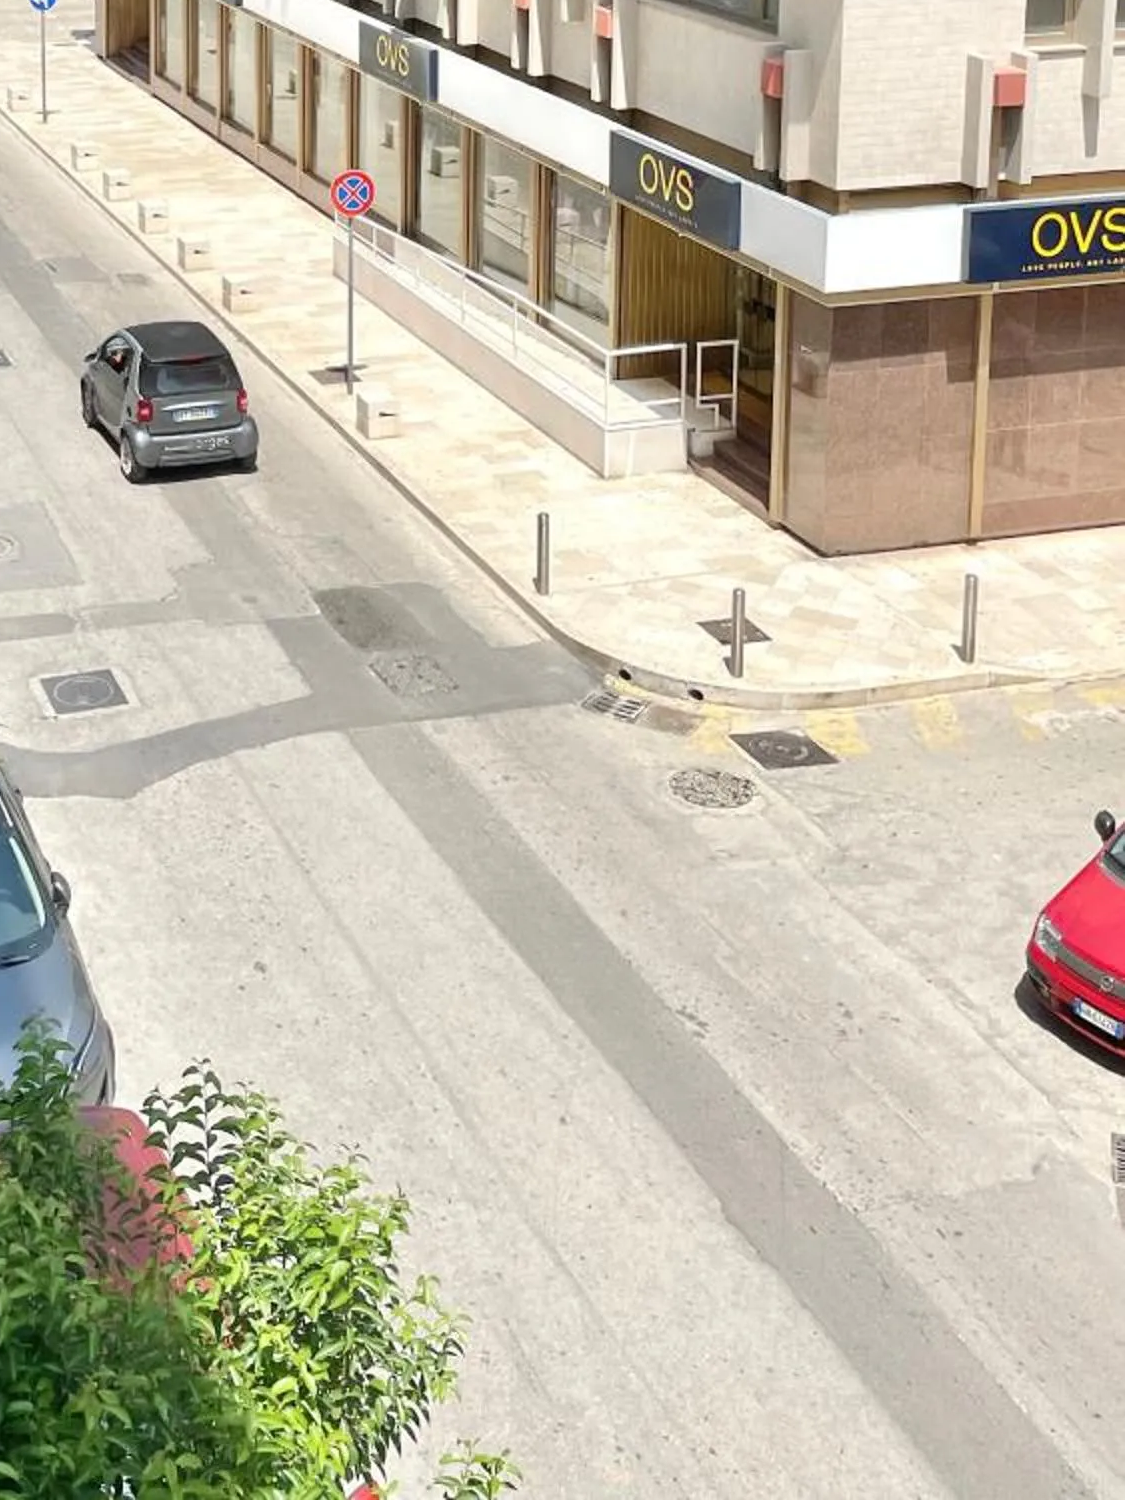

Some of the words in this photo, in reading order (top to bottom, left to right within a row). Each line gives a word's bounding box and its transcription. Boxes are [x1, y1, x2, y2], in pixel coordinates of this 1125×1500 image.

[376, 35, 410, 77] OVS
[639, 153, 694, 212] OVS
[1031, 206, 1125, 258] OVS
